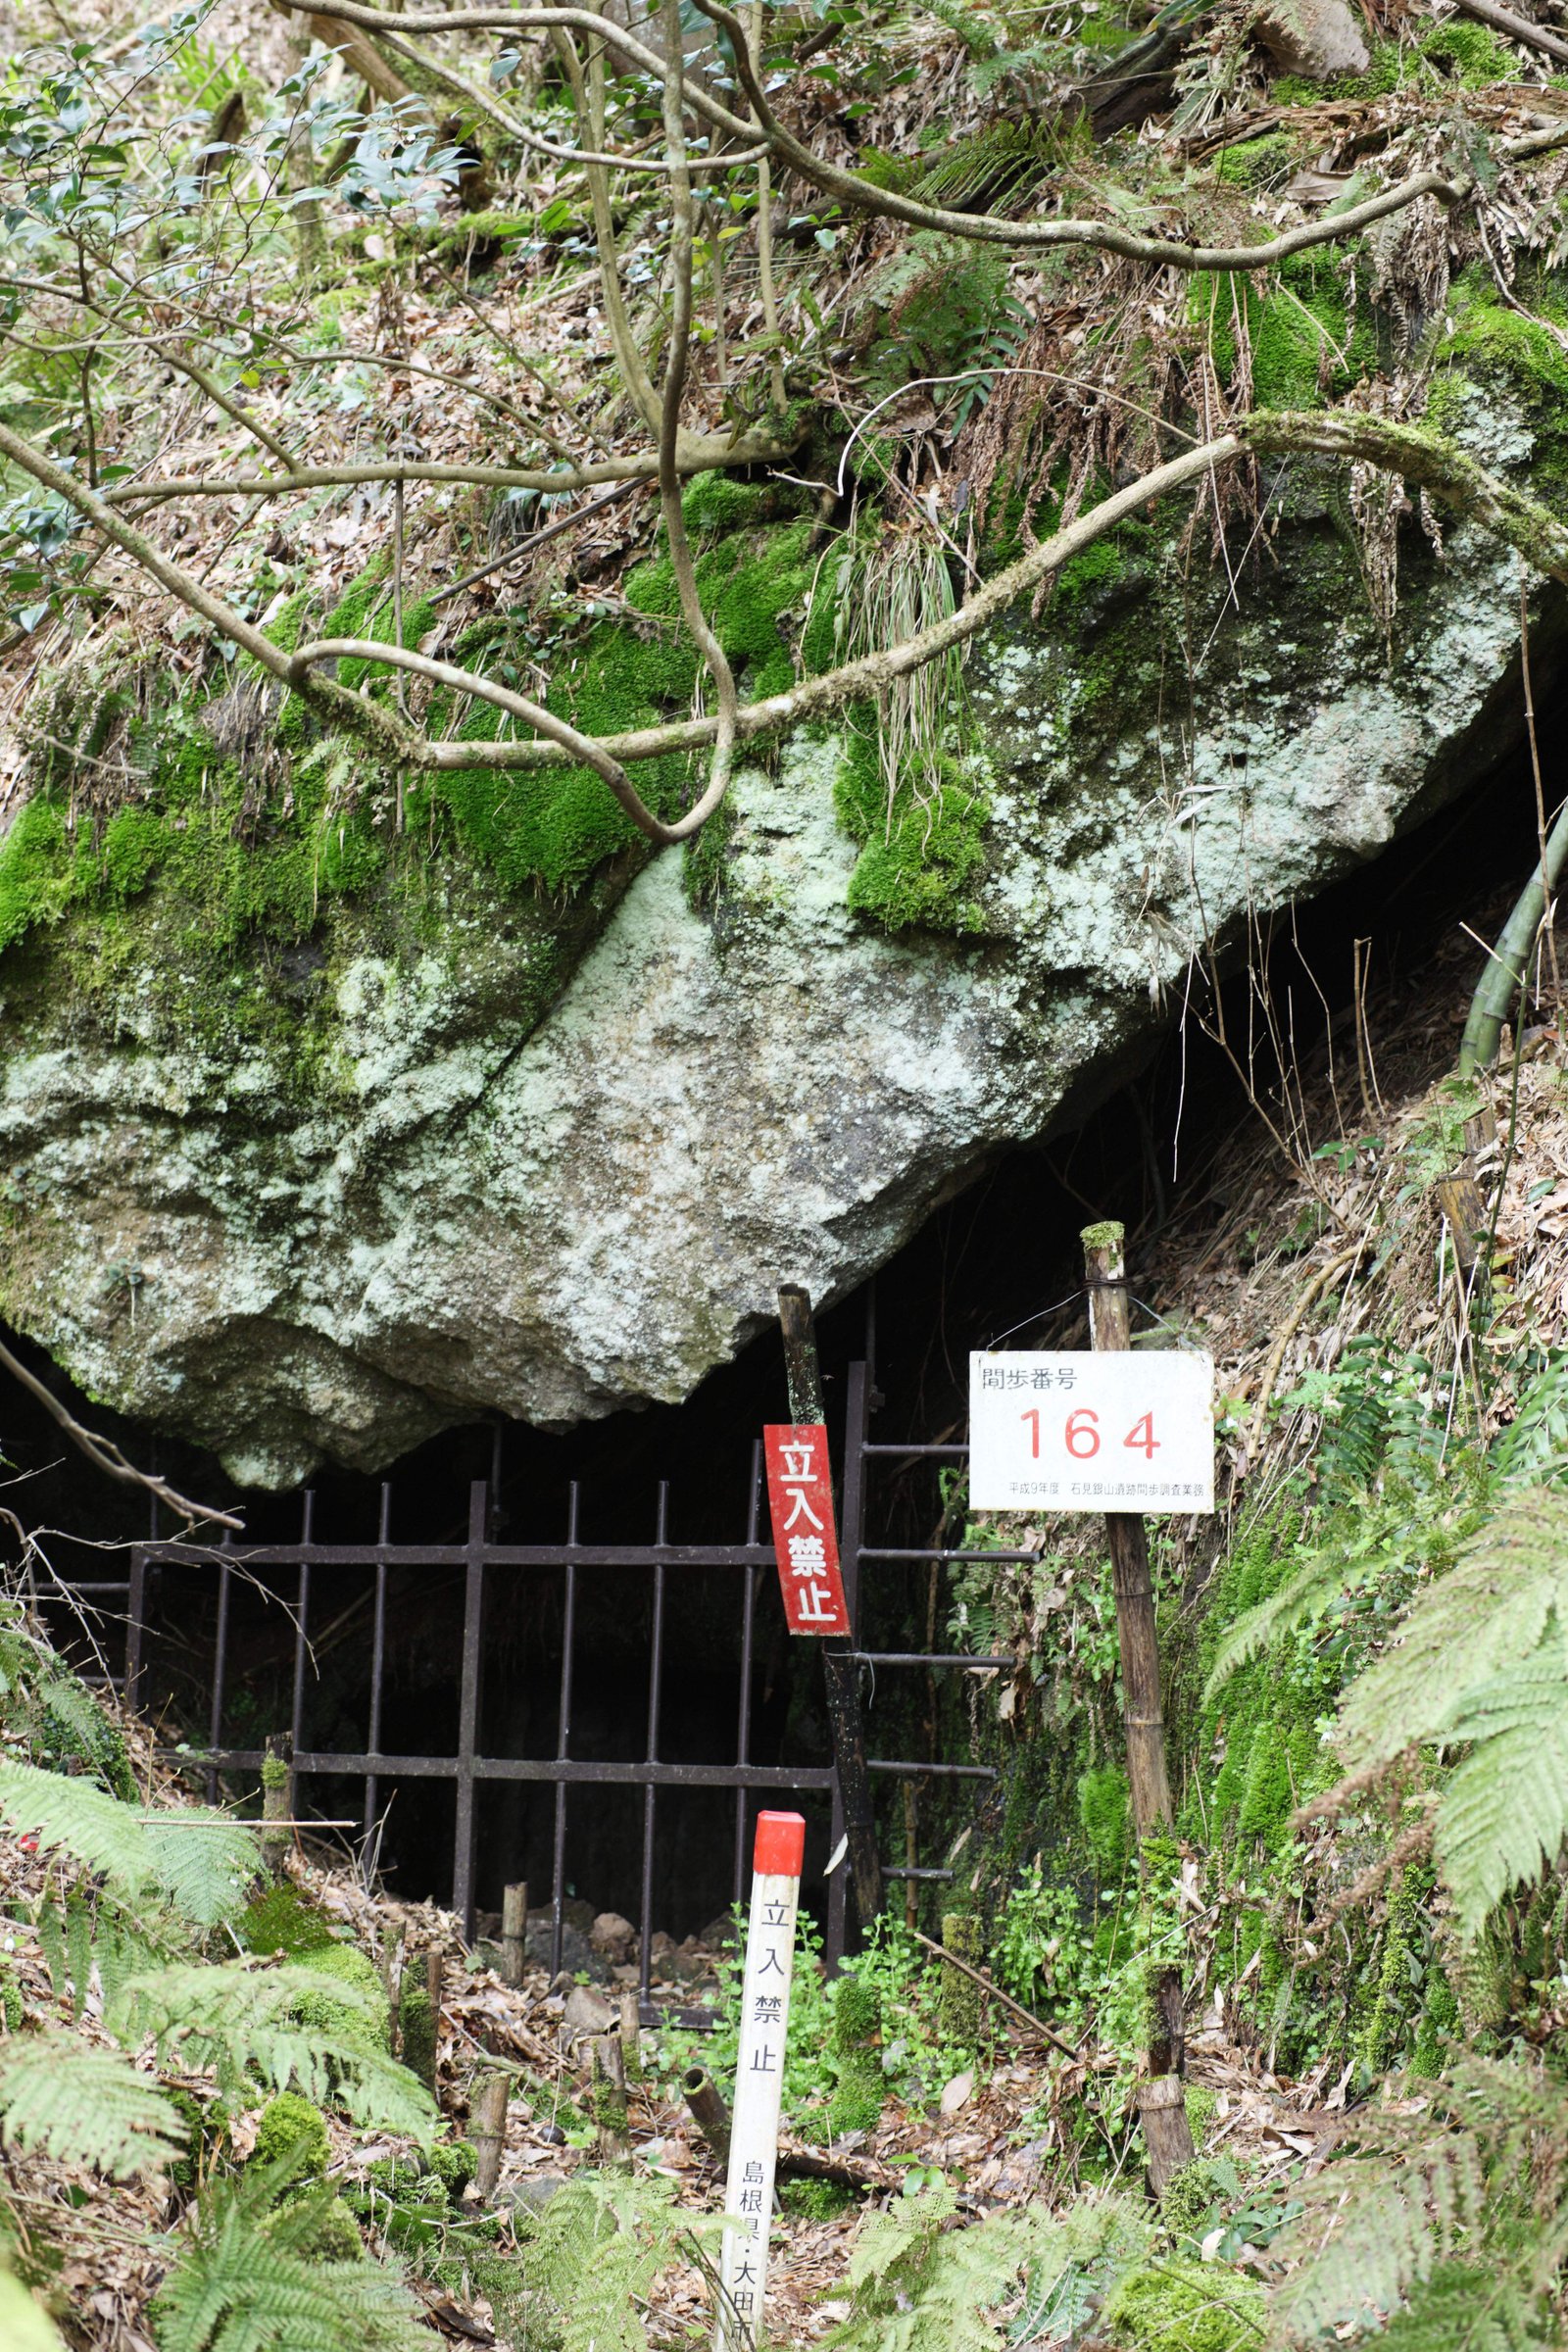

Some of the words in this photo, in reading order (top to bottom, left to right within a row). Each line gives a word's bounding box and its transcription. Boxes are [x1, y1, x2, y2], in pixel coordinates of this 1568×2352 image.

[982, 1367, 1078, 1390] 間歩番号
[1020, 1408, 1161, 1460] 164
[1008, 1482, 1059, 1495] 平成9年度
[778, 1440, 837, 1622] 立入禁止
[749, 1898, 790, 2072] 立入禁止
